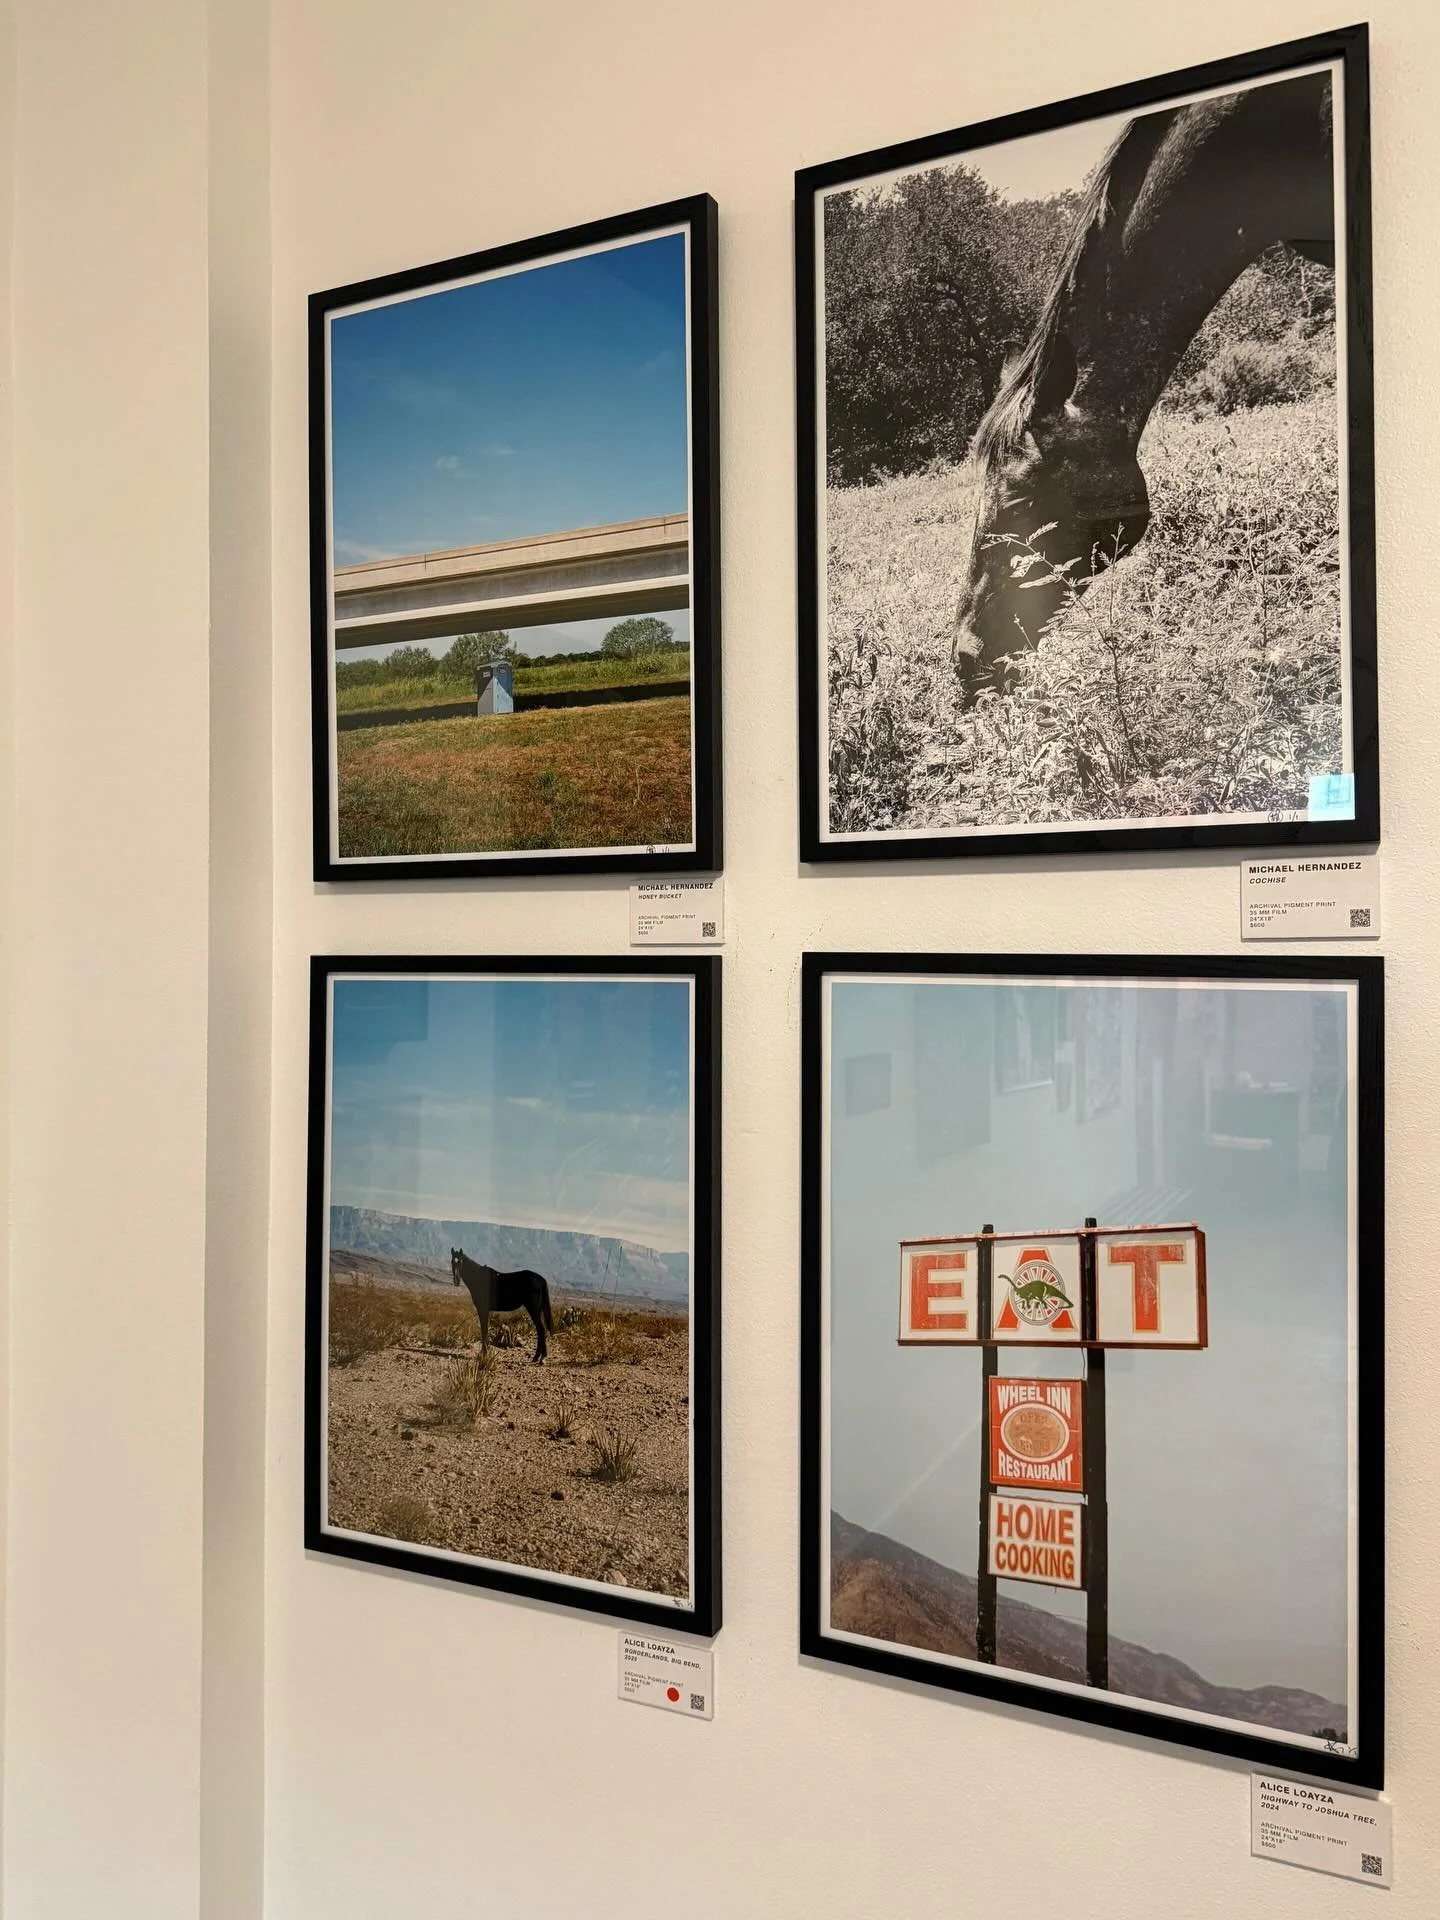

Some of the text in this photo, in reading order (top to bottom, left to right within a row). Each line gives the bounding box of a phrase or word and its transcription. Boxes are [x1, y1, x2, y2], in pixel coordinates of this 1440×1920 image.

[1249, 862, 1362, 874] MICHAEL HERNANDEZ
[670, 882, 714, 890] HERNANDEZ
[1249, 876, 1286, 884] COCHISE
[909, 1240, 1188, 1334] EAT
[997, 1385, 1072, 1418] WHEEL INN
[998, 1448, 1074, 1482] RESTAURANT
[996, 1502, 1074, 1546] HOME
[995, 1540, 1075, 1580] COOKING
[624, 1638, 676, 1654] ALICE LOAYZA
[624, 1648, 670, 1663] BORDERLANDS,
[1260, 1781, 1334, 1804] ALICE LOAYZA
[1260, 1802, 1280, 1812] 2024
[1260, 1794, 1378, 1826] HIGHWAY TO JOSHUA TREE,
[1260, 1822, 1348, 1847] ARCHIVAL PIGMENT PRINT
[1283, 1833, 1299, 1841] FILM
